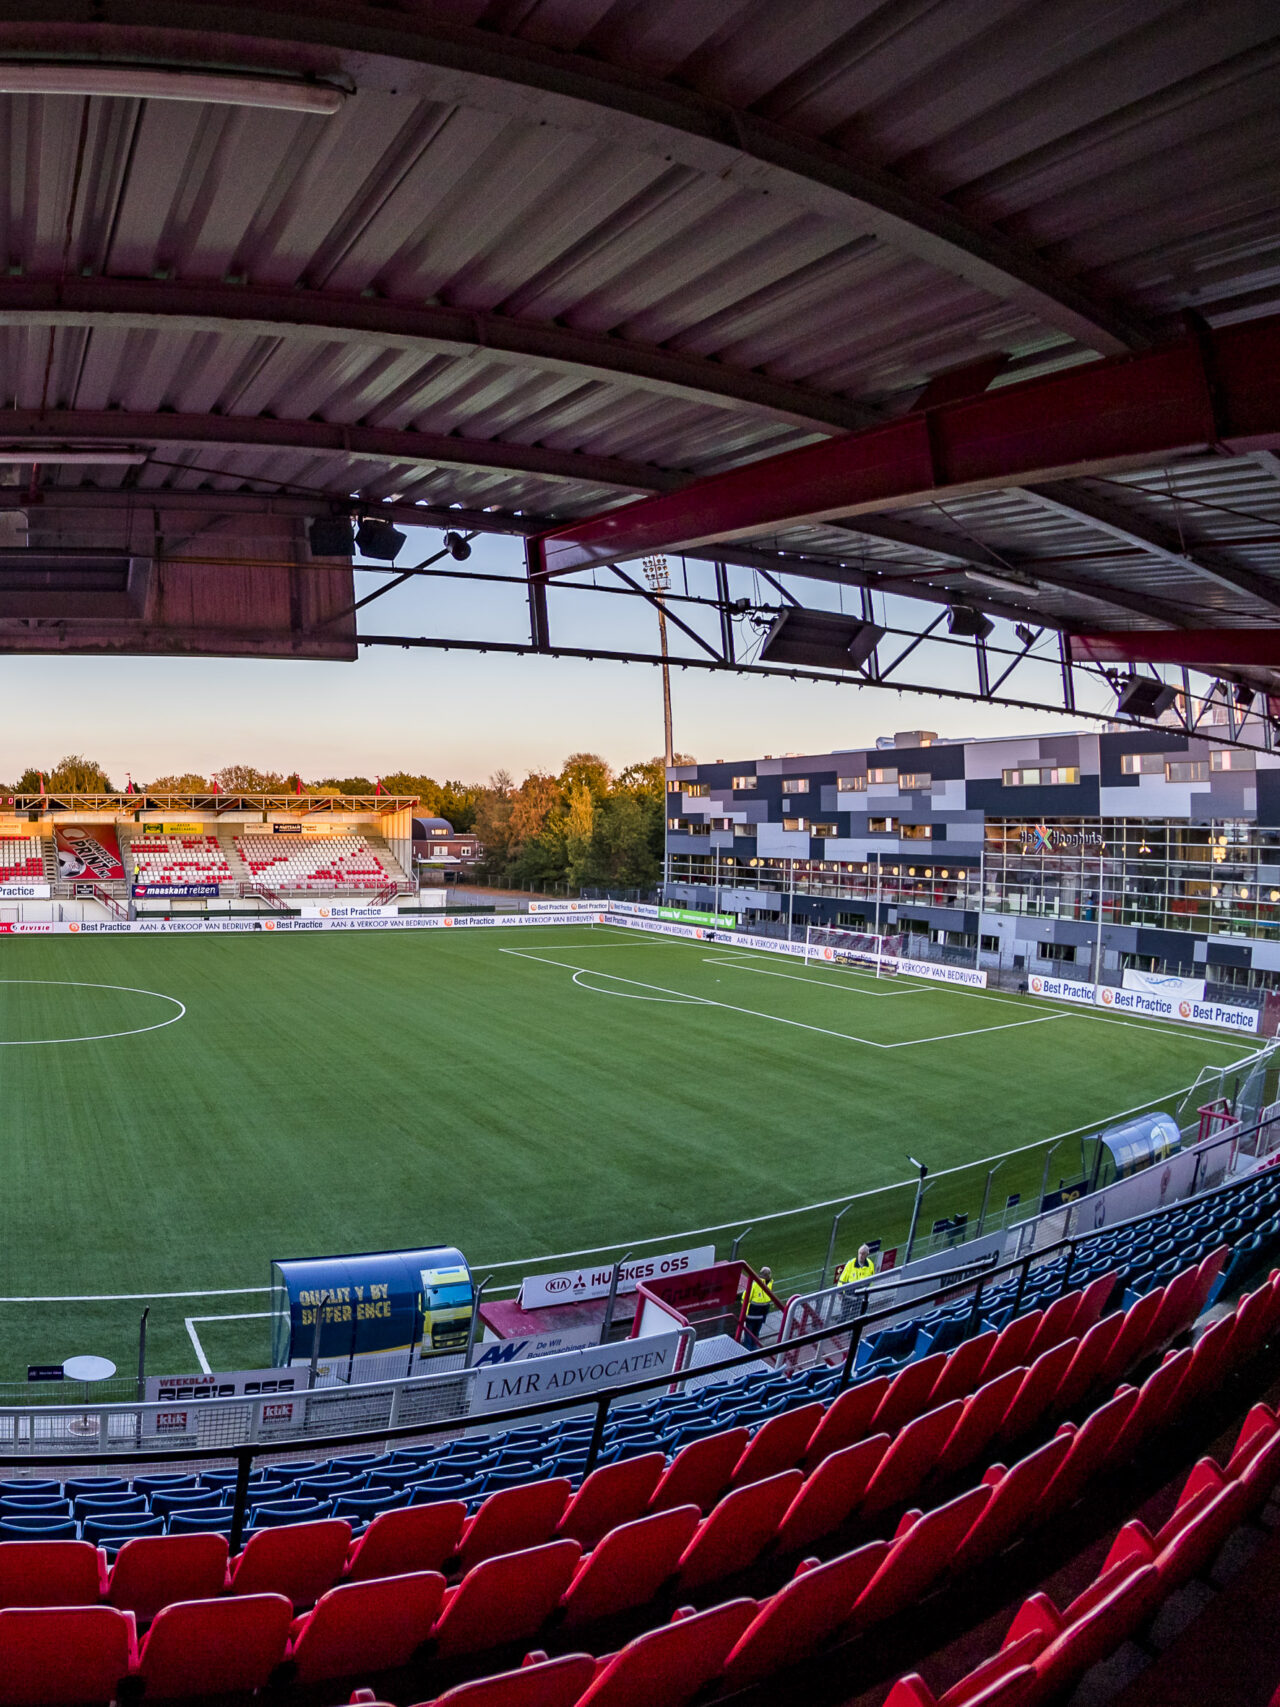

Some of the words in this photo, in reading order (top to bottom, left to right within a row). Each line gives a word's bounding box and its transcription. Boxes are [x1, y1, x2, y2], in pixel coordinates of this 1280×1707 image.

[1052, 831, 1103, 848] Hooghuis
[85, 837, 121, 867] COMPLEET
[147, 885, 188, 895] maaskant
[189, 885, 216, 894] reizen
[331, 908, 348, 916] Best
[350, 907, 381, 916] Practice
[81, 922, 98, 931] Best
[99, 922, 131, 931] Practice
[160, 923, 166, 931] &
[168, 922, 203, 930] VERKOOP
[204, 922, 220, 930] VAN
[222, 922, 258, 930] BEDRIJVE
[276, 921, 293, 929] Best
[295, 920, 323, 929] Practice
[349, 920, 355, 928] &
[356, 920, 389, 928] VERKOOP
[405, 919, 439, 927] BEDRIJVEN
[454, 918, 468, 926] Best
[469, 917, 495, 925] Practice
[524, 916, 552, 924] VERKOOP
[566, 914, 595, 922] BEDRIJVEN
[612, 917, 628, 926] Practice
[644, 922, 662, 931] VERKOOP
[755, 939, 778, 950] VERKOOP
[778, 942, 790, 952] VAN
[901, 962, 931, 974] VERKOOP
[931, 967, 946, 978] VAN
[947, 970, 983, 985] BEDRIJVEN
[1043, 980, 1061, 995] Best
[1063, 984, 1095, 1000] Practice
[1114, 992, 1134, 1006] Best
[1135, 995, 1172, 1014] Practice
[1192, 1004, 1213, 1020] Best
[1215, 1008, 1254, 1027] Practice
[591, 1263, 654, 1287] HUSKES
[660, 1256, 689, 1274] OSS
[370, 1283, 389, 1299] BY
[548, 1339, 562, 1348] Wit
[159, 1376, 215, 1387] WEEKBLAD
[484, 1373, 541, 1401] LMR
[546, 1349, 668, 1390] ADVOCATEN
[244, 1379, 295, 1395] OSS
